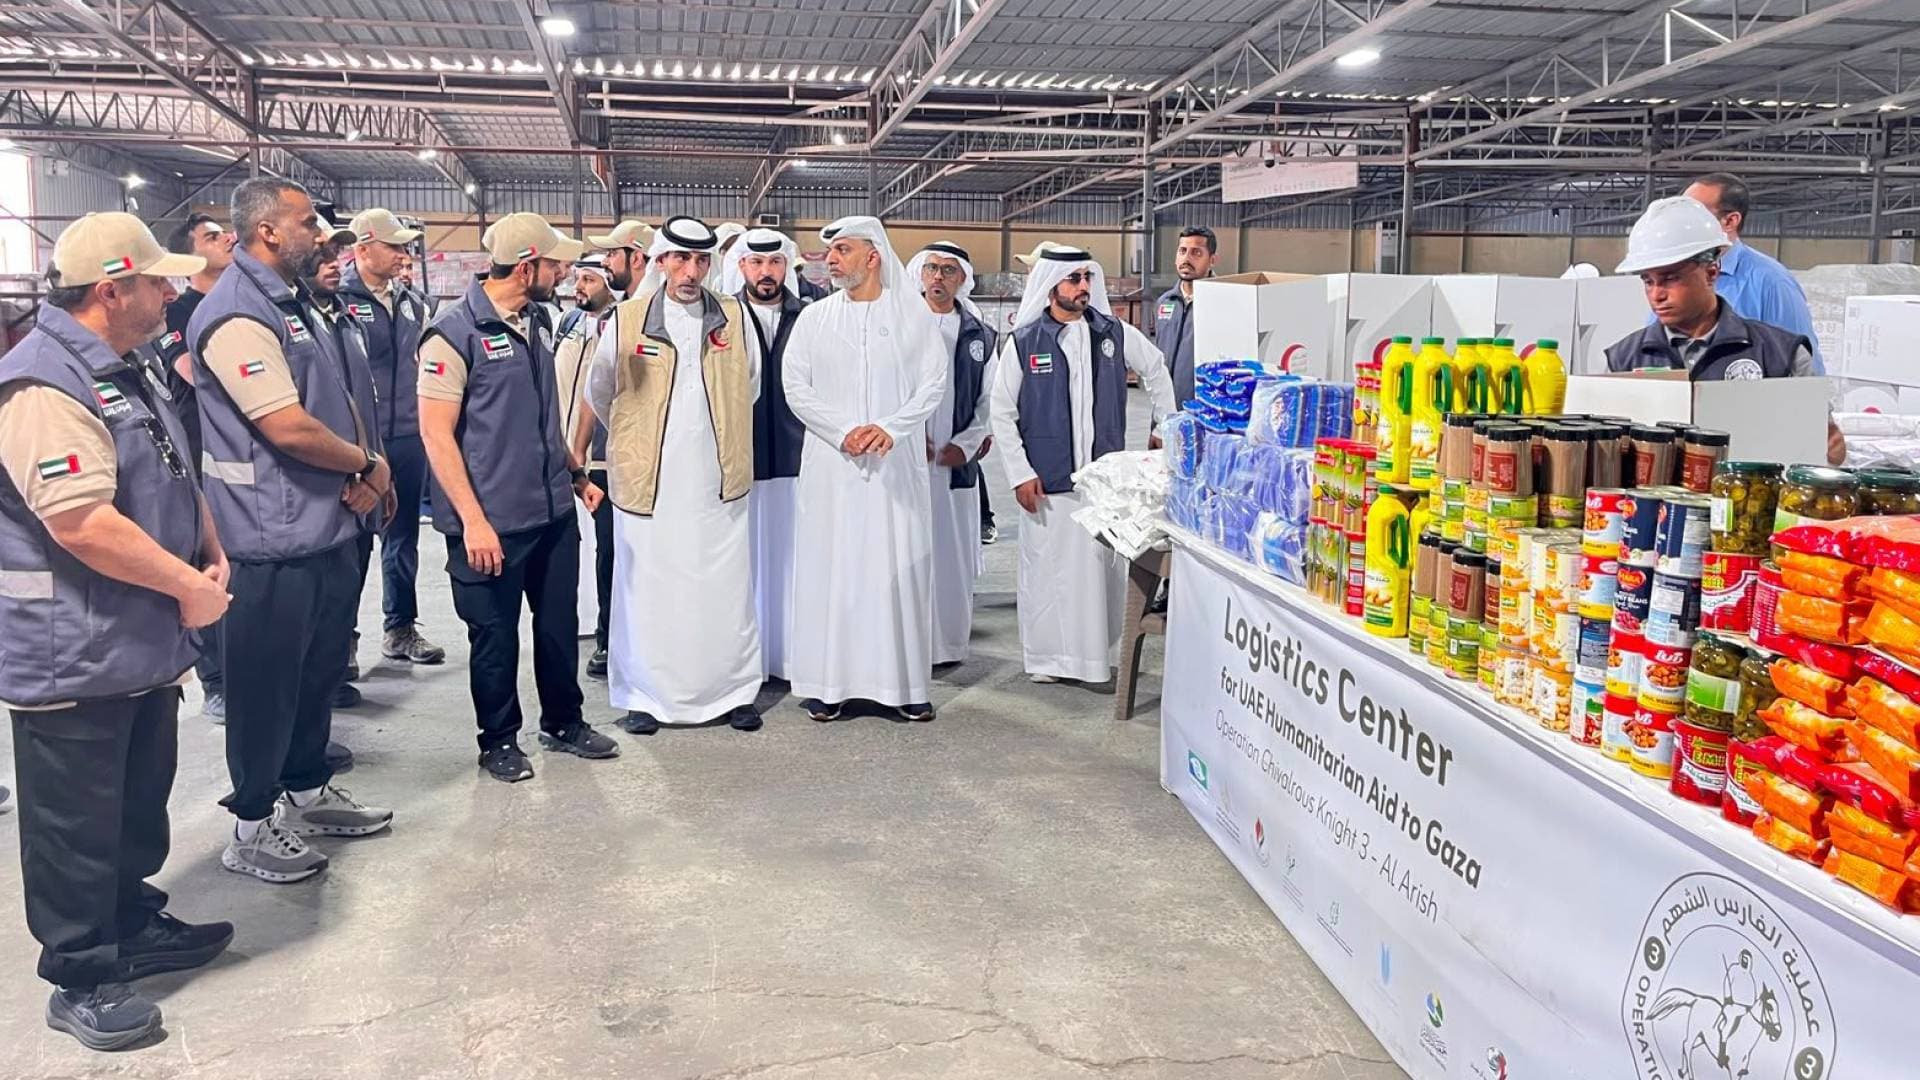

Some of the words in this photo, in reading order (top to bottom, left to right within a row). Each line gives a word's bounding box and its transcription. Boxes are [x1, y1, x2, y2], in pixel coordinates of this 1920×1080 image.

[1224, 597, 1329, 705] Logistics
[1338, 668, 1453, 786] Center
[1221, 666, 1237, 697] for
[1240, 678, 1264, 719] UAE
[1265, 698, 1364, 798] Humanitarian
[1366, 776, 1399, 823] Aid
[1401, 802, 1421, 840] to
[1426, 820, 1482, 888] Gaza
[1216, 709, 1260, 764] Operation
[1261, 749, 1314, 813] Chivalrous
[1316, 796, 1358, 850] Knight
[1358, 832, 1370, 860] 3
[1379, 853, 1399, 887] Al
[1398, 869, 1438, 923] Arish
[1662, 886, 1710, 946] الشهم
[1714, 897, 1782, 949] الفارس
[1649, 943, 1661, 966] 3
[1782, 948, 1820, 1037] عملية
[1800, 1054, 1817, 1078] 3
